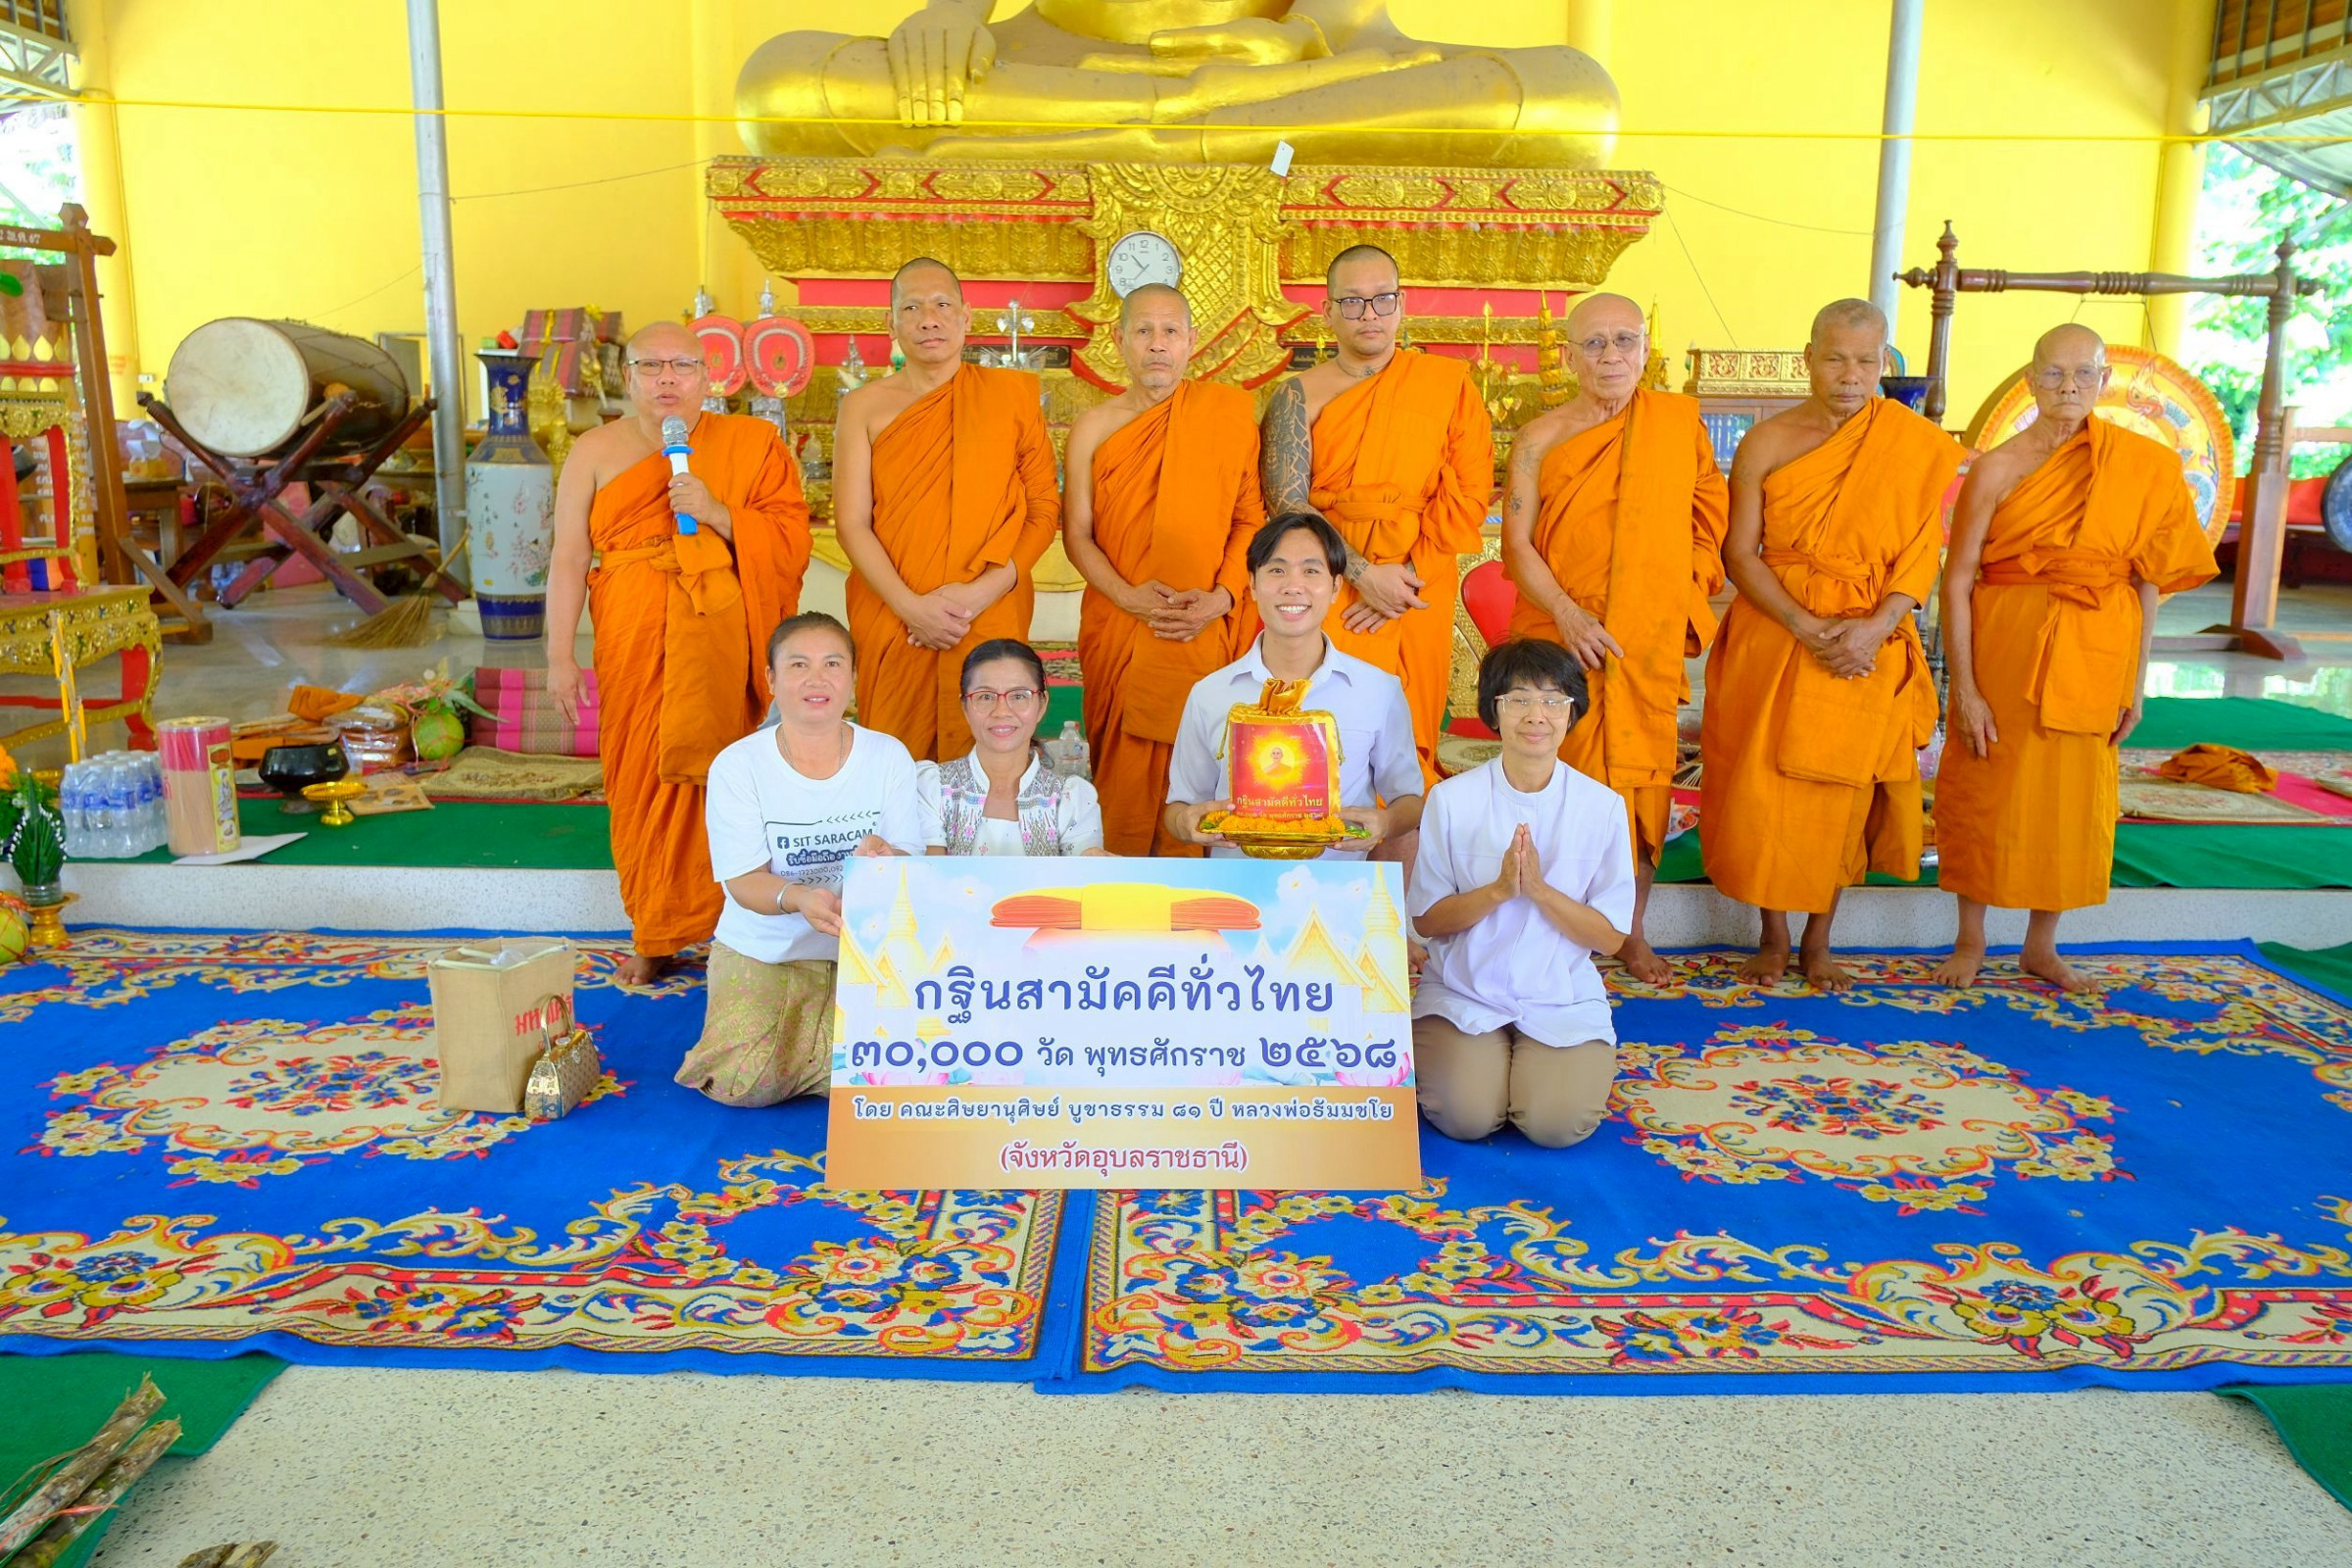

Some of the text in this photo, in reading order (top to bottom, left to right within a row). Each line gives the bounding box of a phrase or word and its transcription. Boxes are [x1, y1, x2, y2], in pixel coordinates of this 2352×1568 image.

[1129, 242, 1136, 251] 11
[1140, 239, 1149, 249] 12
[1118, 253, 1128, 262] 10
[1162, 252, 1169, 262] 2
[1115, 265, 1123, 274] 9
[1165, 266, 1173, 274] 3
[1119, 277, 1127, 287] 8
[793, 836, 811, 848] SIT
[914, 953, 1334, 1024] กฐินสามัคคีทั่วไทย
[851, 1036, 1397, 1078] ๓๐,๐๐๐ วัด พุทธศักราช ๒๕๖๘
[855, 1096, 1394, 1124] โดย คณะศิษยานุศิษย์ บูชาธรรม ๘๑ ปี หลวงพ่อธัมมชโย
[1001, 1140, 1249, 1178] (จังหวัดอุบลราชธานี)
